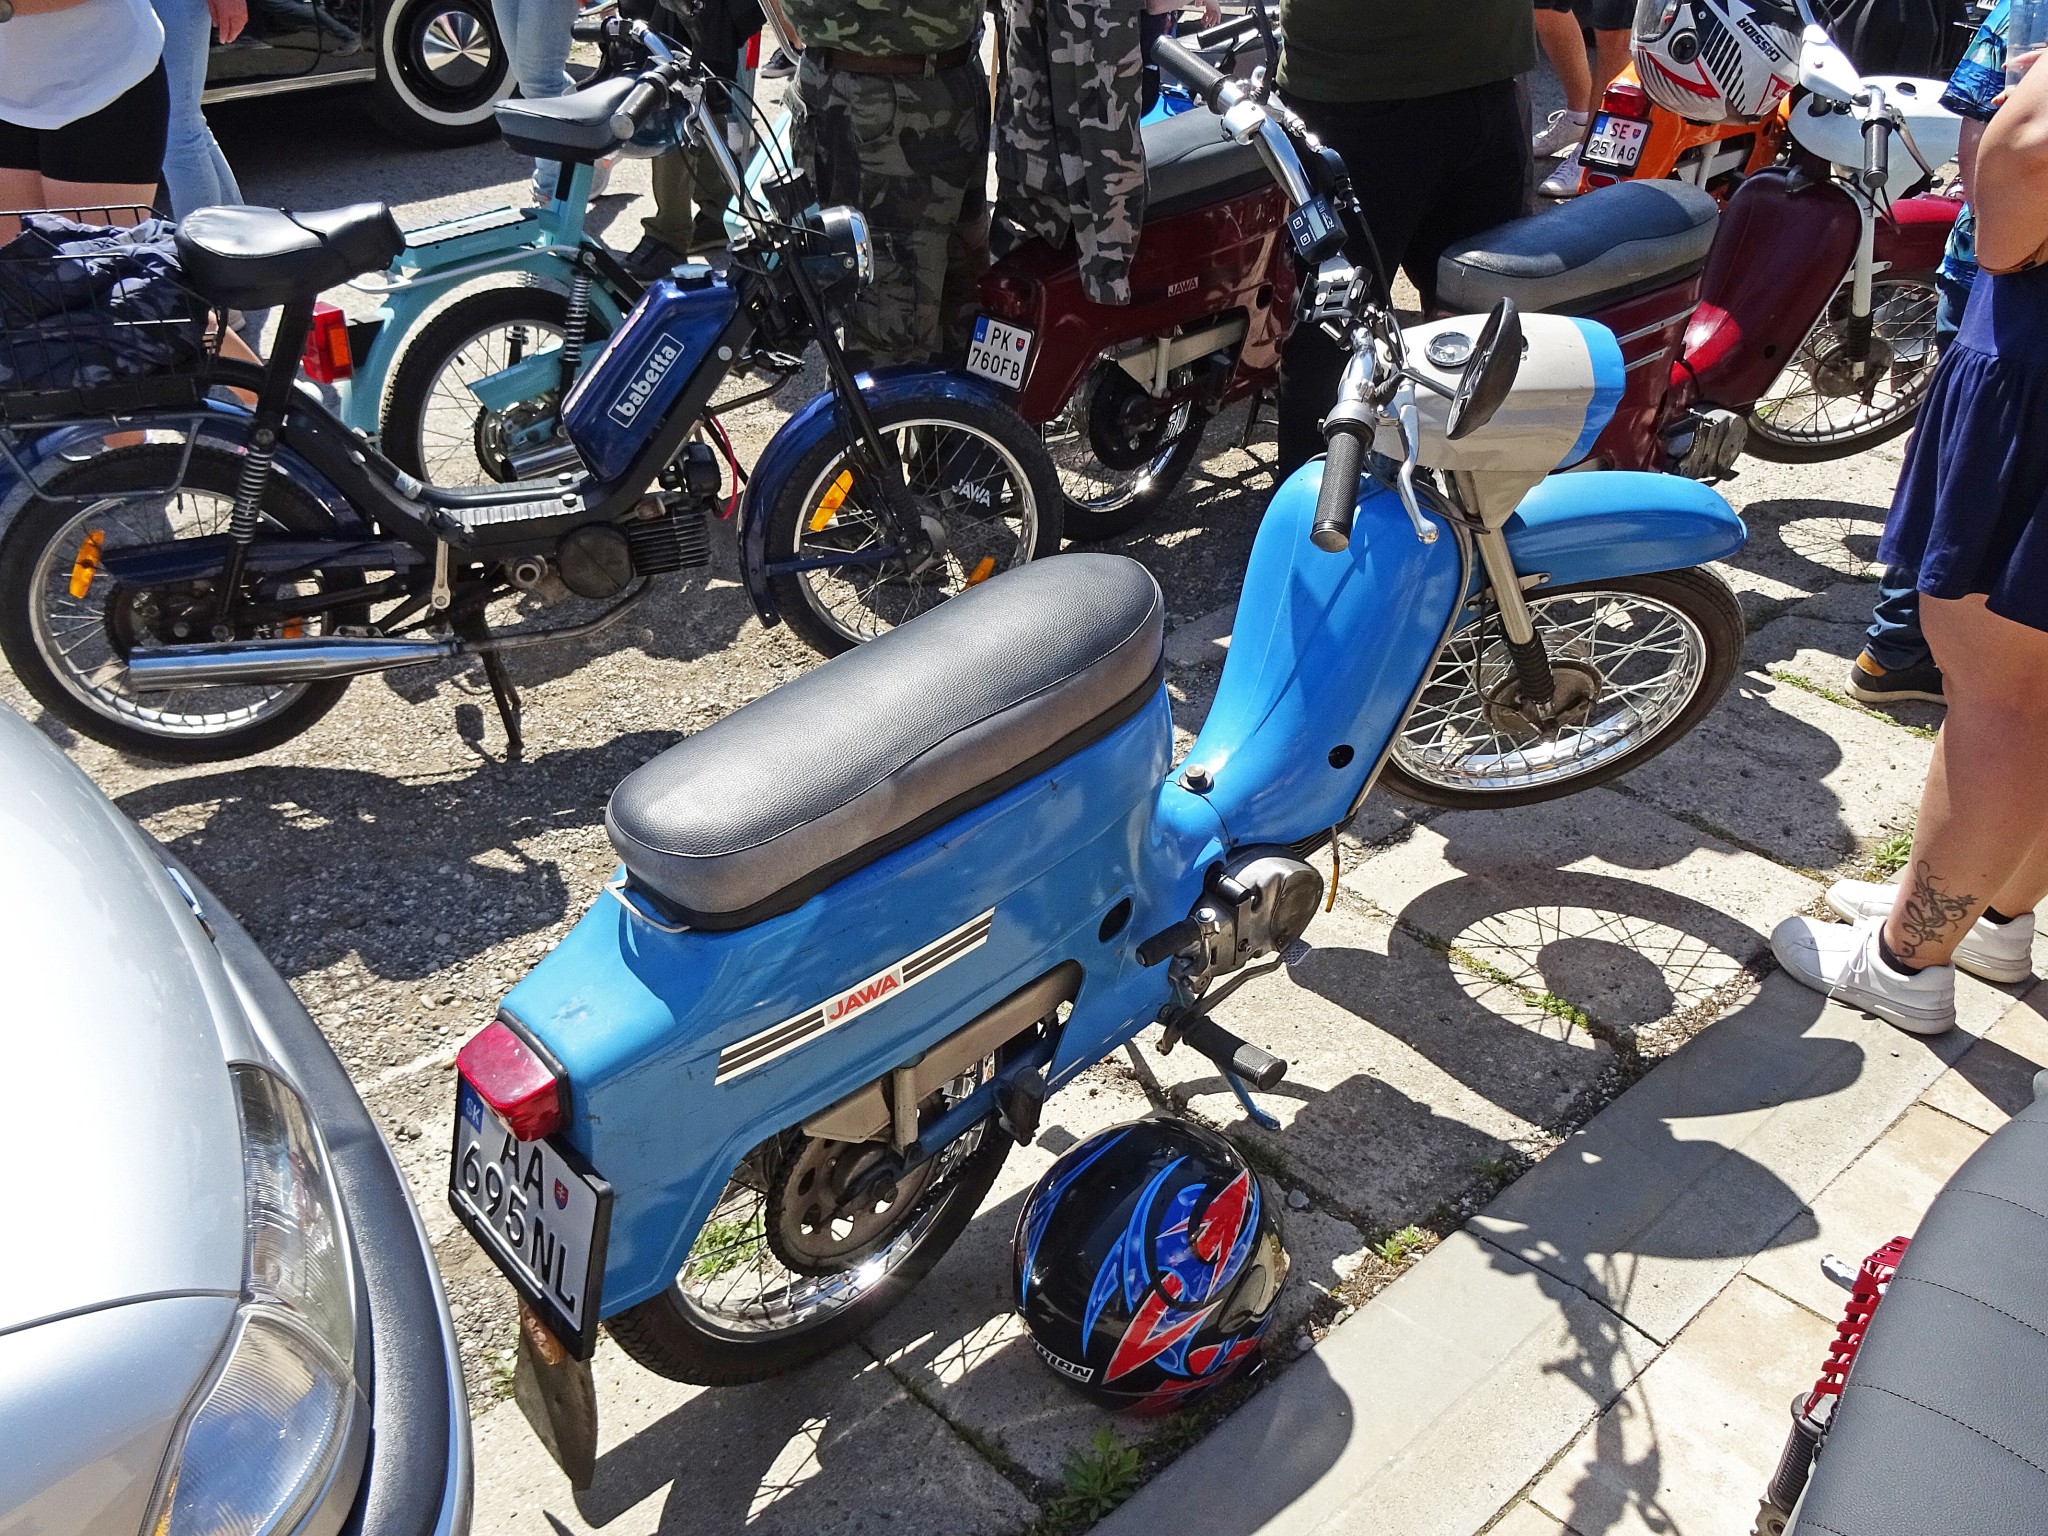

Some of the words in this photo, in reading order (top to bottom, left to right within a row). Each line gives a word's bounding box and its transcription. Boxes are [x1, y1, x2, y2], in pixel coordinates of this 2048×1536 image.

[1736, 18, 1781, 62] CASSIDA
[1610, 123, 1630, 139] SE
[1590, 140, 1636, 160] 251AG
[1169, 279, 1197, 296] JAWA
[991, 327, 1012, 351] PK
[971, 348, 1020, 381] 760FB
[615, 346, 677, 417] babetta
[952, 479, 990, 507] JAWA
[829, 974, 899, 1020] JAWA
[465, 1098, 481, 1127] SK
[500, 1132, 544, 1209] AA
[462, 1140, 575, 1314] 695NL
